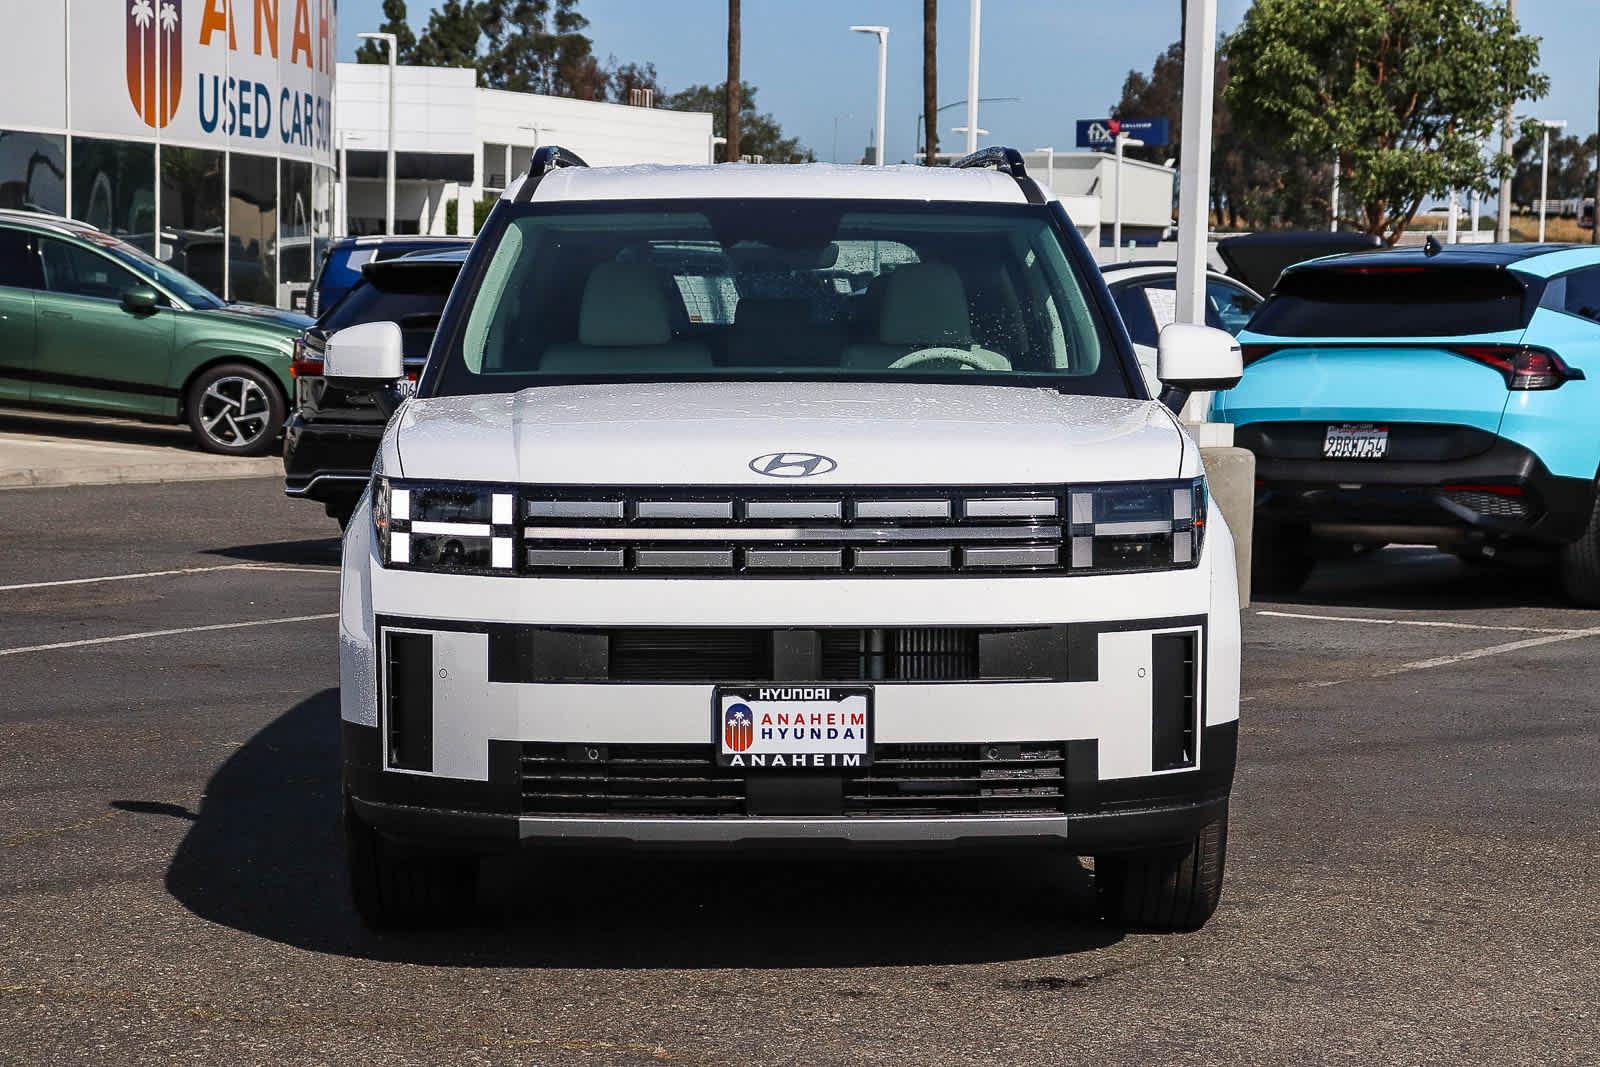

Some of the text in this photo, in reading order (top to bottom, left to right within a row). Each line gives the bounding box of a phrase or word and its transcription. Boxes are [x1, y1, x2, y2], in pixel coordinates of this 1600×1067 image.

[199, 73, 271, 139] USED
[280, 87, 313, 147] CAR
[1087, 123, 1114, 142] fix
[759, 688, 831, 700] HYUNDAI
[761, 713, 865, 726] ANAHEIM
[761, 727, 865, 740] HYUNDAI
[730, 754, 861, 767] ANAHEIM
